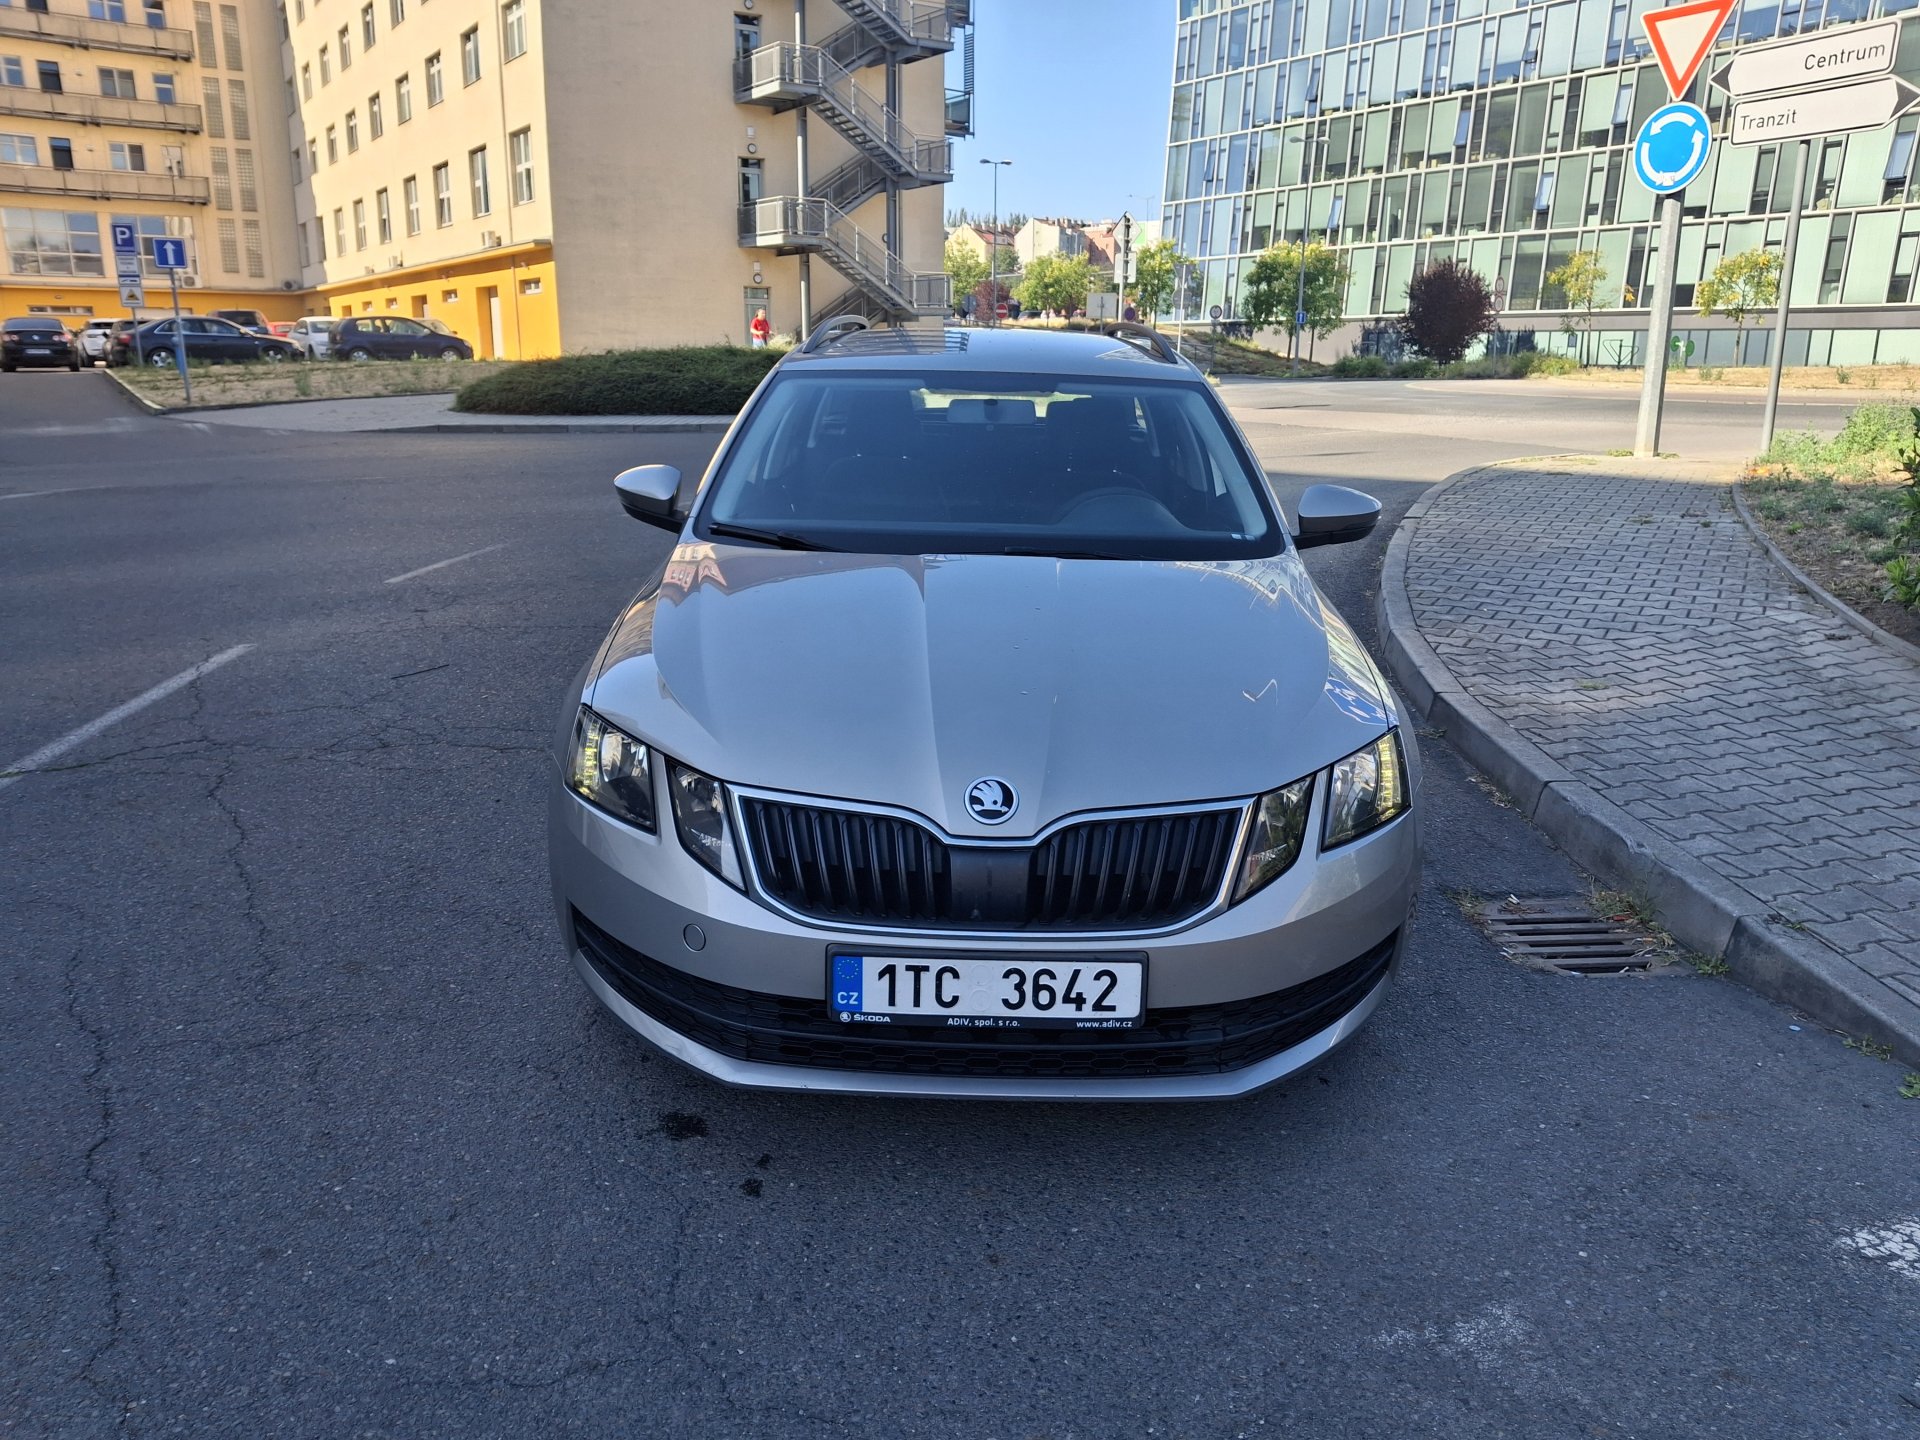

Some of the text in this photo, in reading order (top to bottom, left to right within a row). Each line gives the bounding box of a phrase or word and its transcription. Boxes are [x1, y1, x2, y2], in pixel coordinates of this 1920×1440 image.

[1804, 44, 1885, 71] Centrum
[1740, 109, 1797, 131] Tranzit
[115, 227, 130, 245] P
[878, 964, 1118, 1012] 1TC 3642
[837, 991, 858, 1005] CZ
[853, 1013, 891, 1023] ŠKODA
[947, 1017, 972, 1027] ADIV,
[974, 1018, 996, 1028] spol.
[1076, 1019, 1133, 1028] www.adiv.cz
